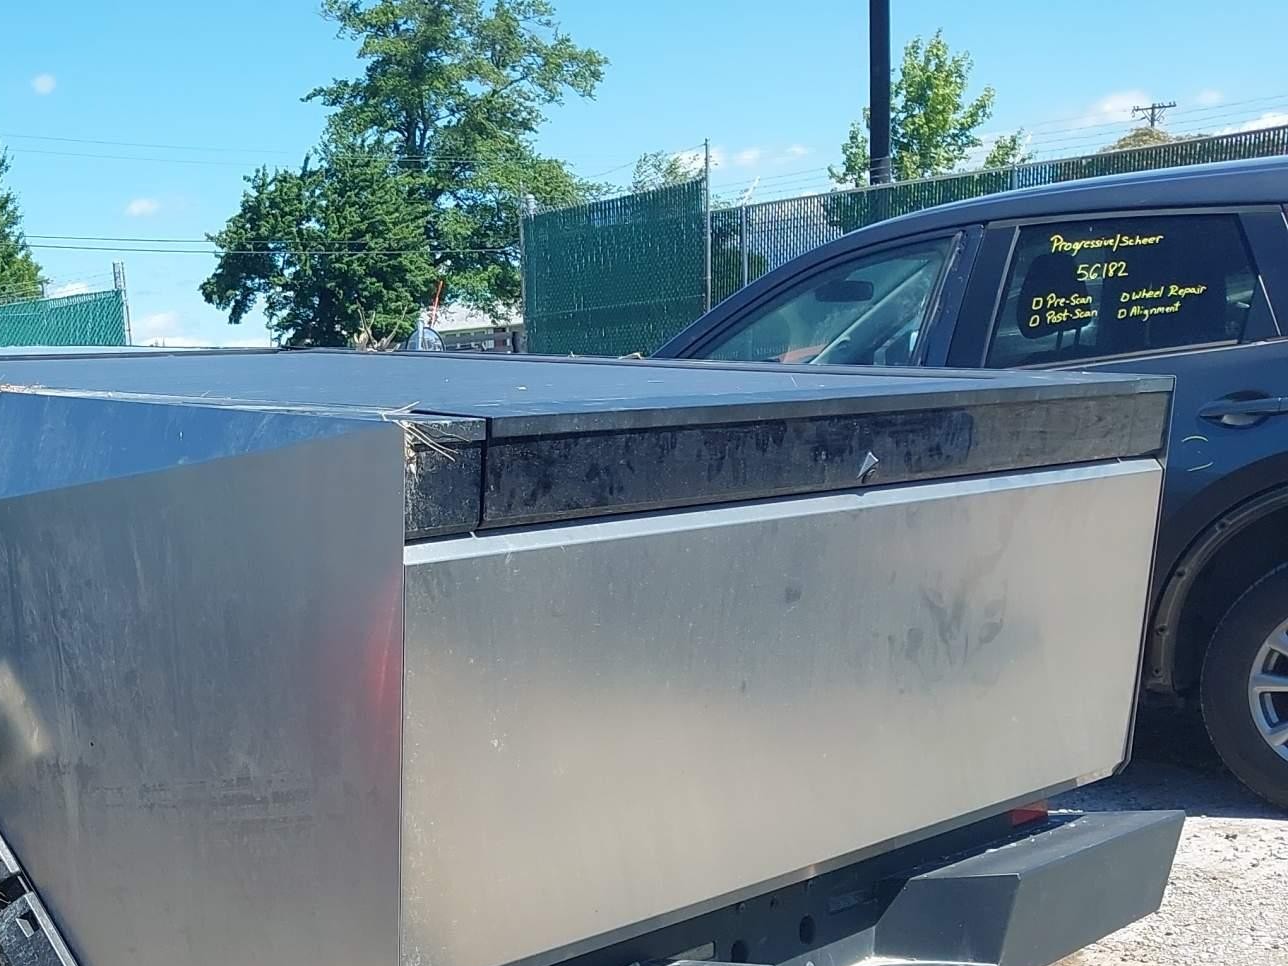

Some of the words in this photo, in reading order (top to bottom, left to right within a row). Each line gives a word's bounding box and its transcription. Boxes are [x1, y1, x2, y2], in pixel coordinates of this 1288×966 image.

[1077, 262, 1128, 281] 56182
[1168, 284, 1207, 298] Repair
[1046, 294, 1093, 308] Pre-Scan
[1046, 308, 1098, 324] Post-Scan
[1130, 301, 1181, 321] Alignment
